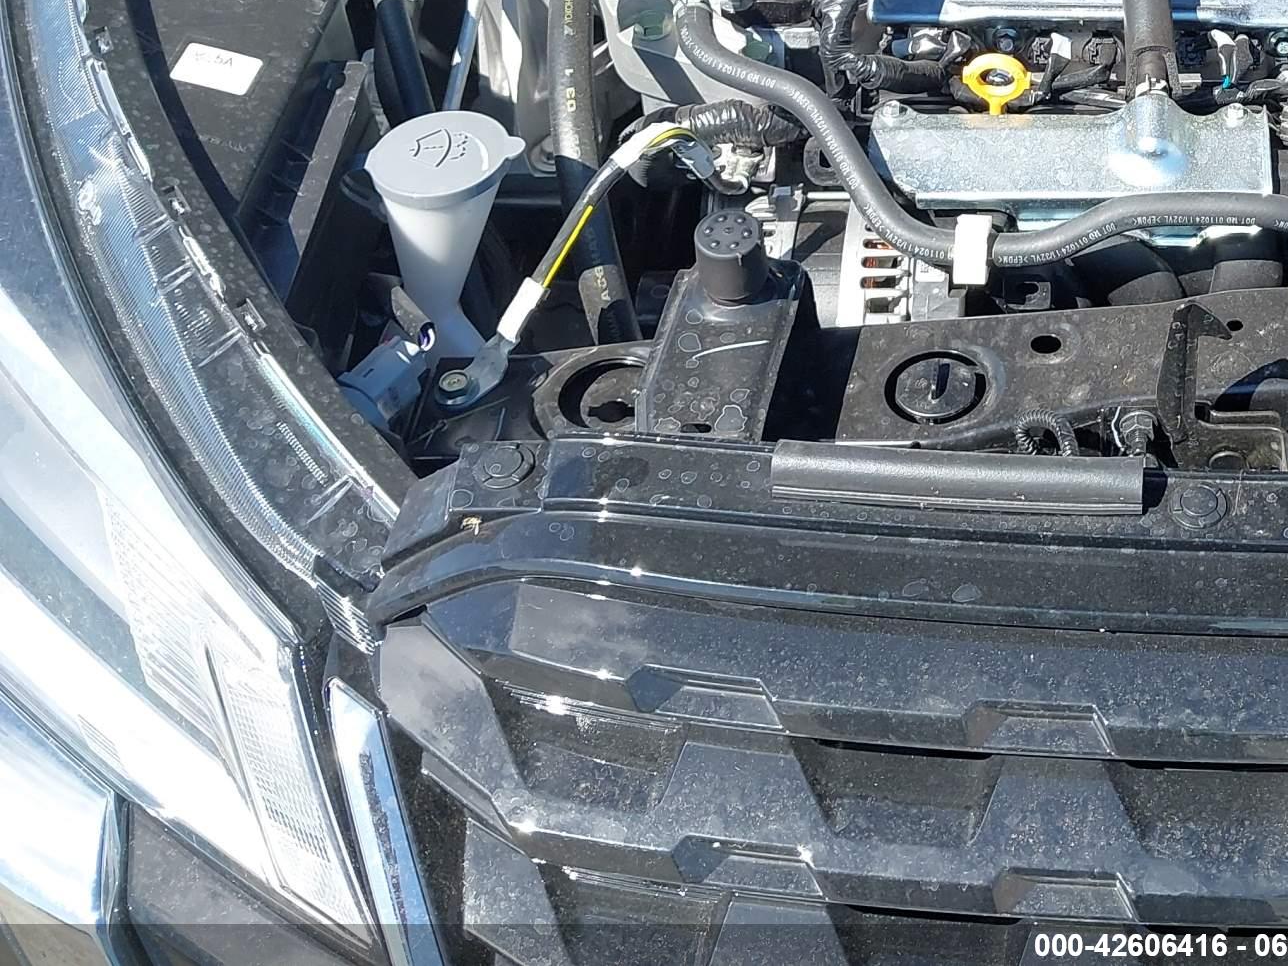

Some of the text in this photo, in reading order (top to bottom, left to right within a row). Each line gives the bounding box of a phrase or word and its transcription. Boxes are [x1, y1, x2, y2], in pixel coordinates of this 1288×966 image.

[1132, 216, 1161, 225] >EPDM<
[1195, 217, 1224, 225] 011024
[1061, 236, 1088, 255] 011024
[914, 246, 945, 259] 011024
[998, 255, 1028, 264] >EPDM<
